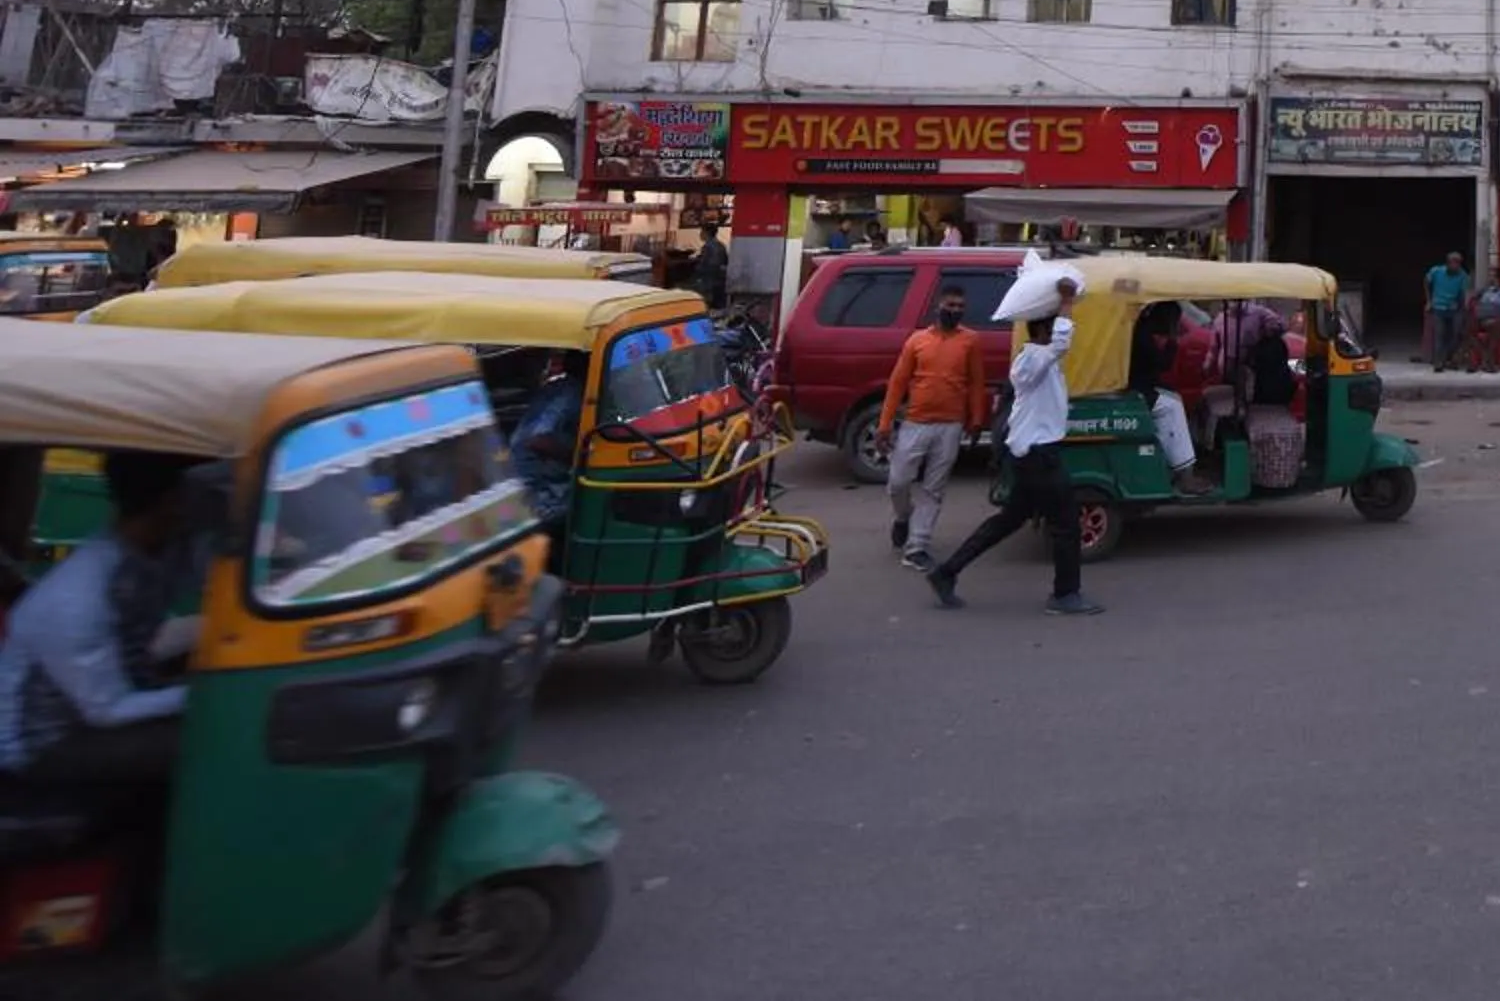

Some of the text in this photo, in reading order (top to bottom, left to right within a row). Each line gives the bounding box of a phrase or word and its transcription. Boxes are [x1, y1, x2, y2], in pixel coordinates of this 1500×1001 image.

[741, 114, 1084, 152] SATKAR SWEETS
[1309, 108, 1364, 130] भारत
[1366, 106, 1479, 132] भोजनालय
